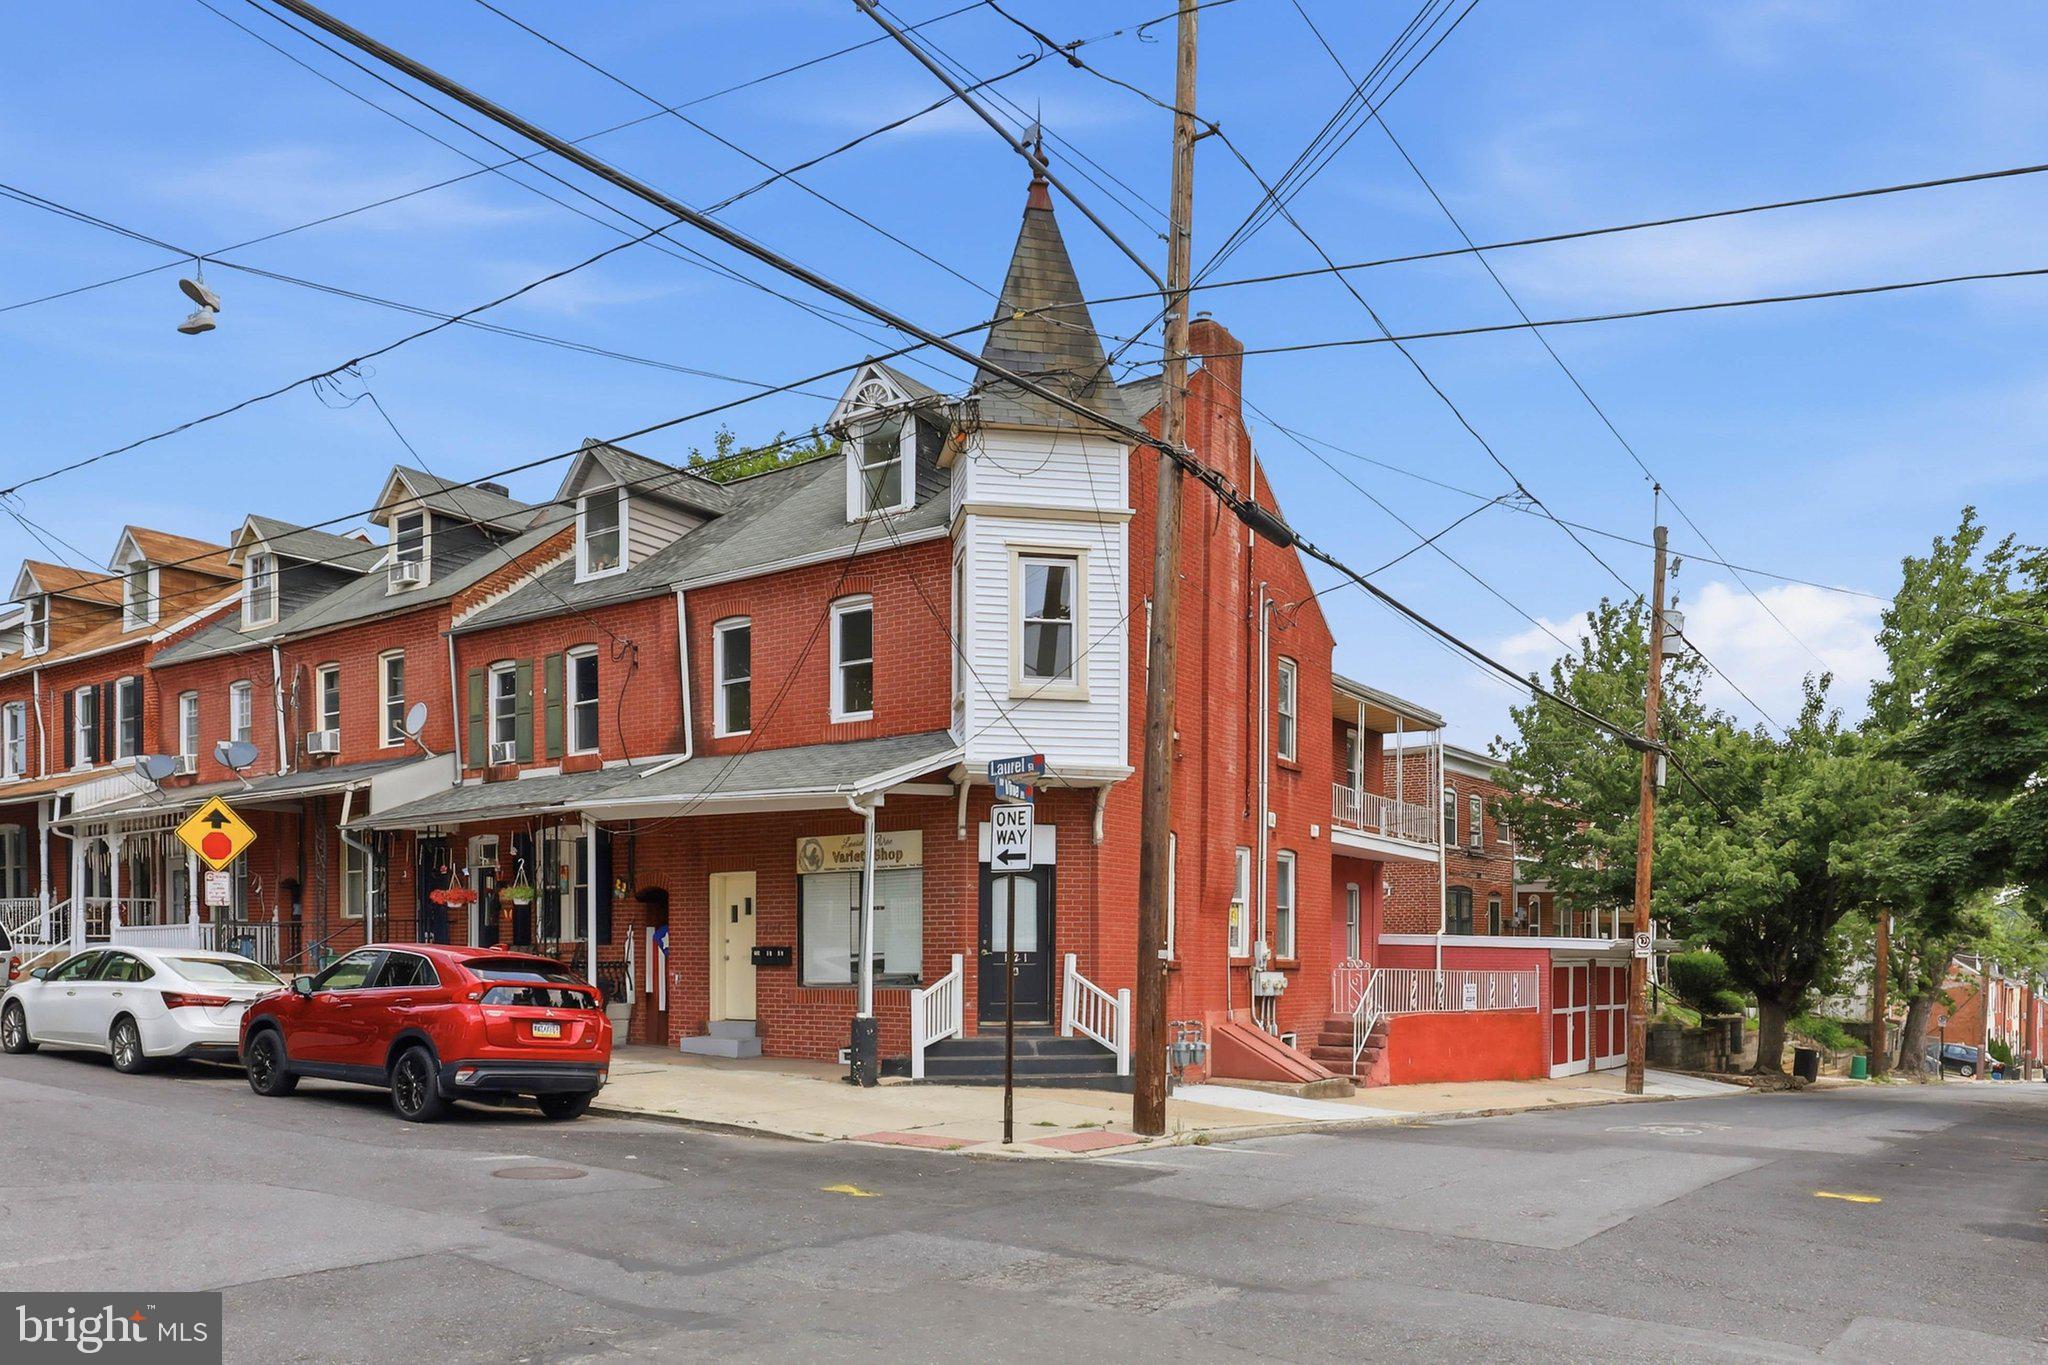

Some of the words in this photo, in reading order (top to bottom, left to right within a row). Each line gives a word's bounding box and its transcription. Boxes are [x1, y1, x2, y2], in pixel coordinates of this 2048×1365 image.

[990, 757, 1025, 776] Laurel
[996, 811, 1026, 826] ONE
[996, 829, 1027, 845] WAY
